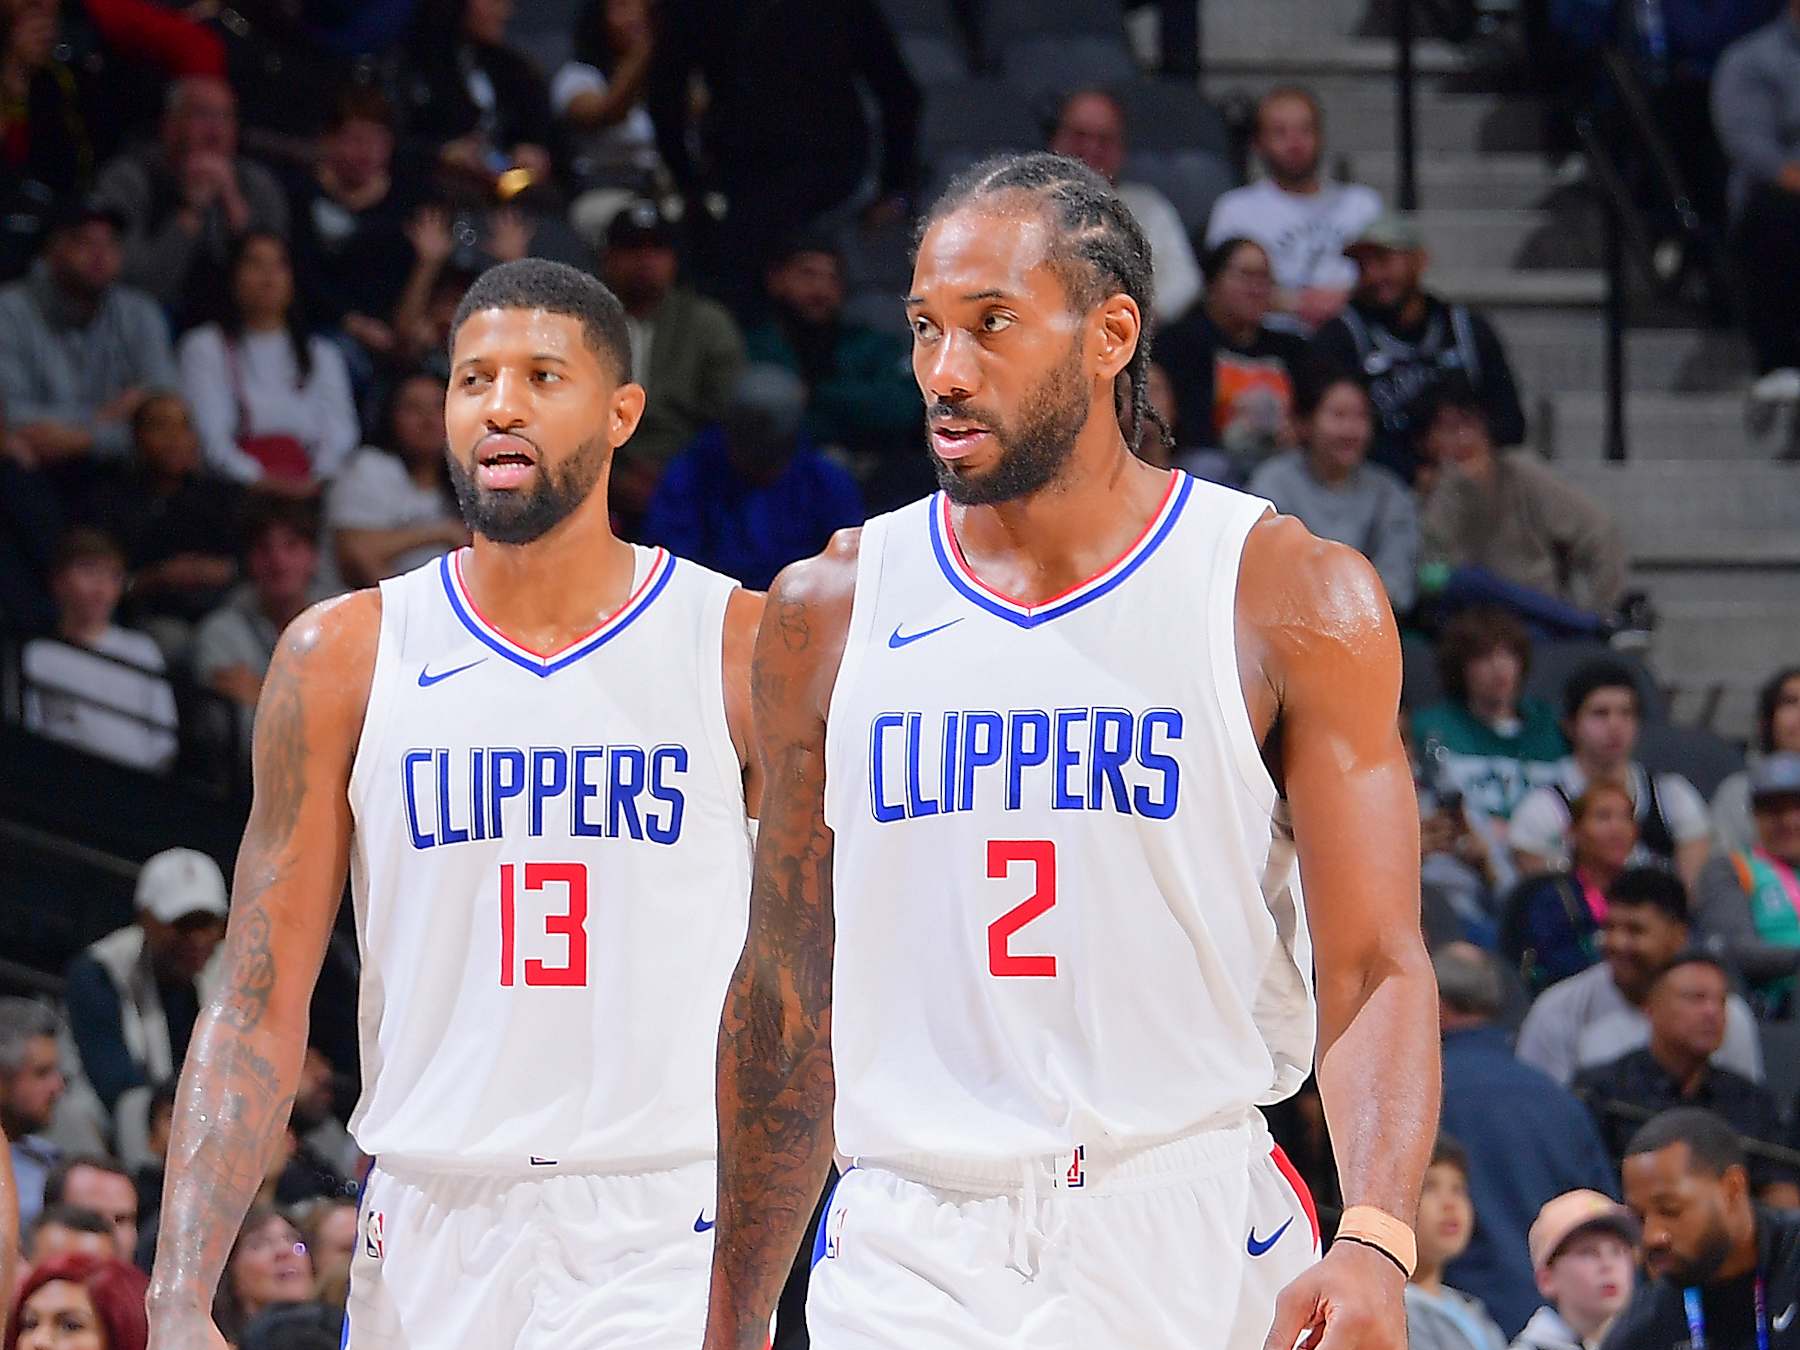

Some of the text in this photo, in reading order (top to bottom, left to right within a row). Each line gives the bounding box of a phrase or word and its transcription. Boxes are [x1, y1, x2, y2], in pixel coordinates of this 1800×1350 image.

[401, 743, 689, 850] CLIPPERS
[868, 706, 1183, 823] CLIPPERS
[499, 862, 588, 987] 13
[986, 839, 1057, 978] 2
